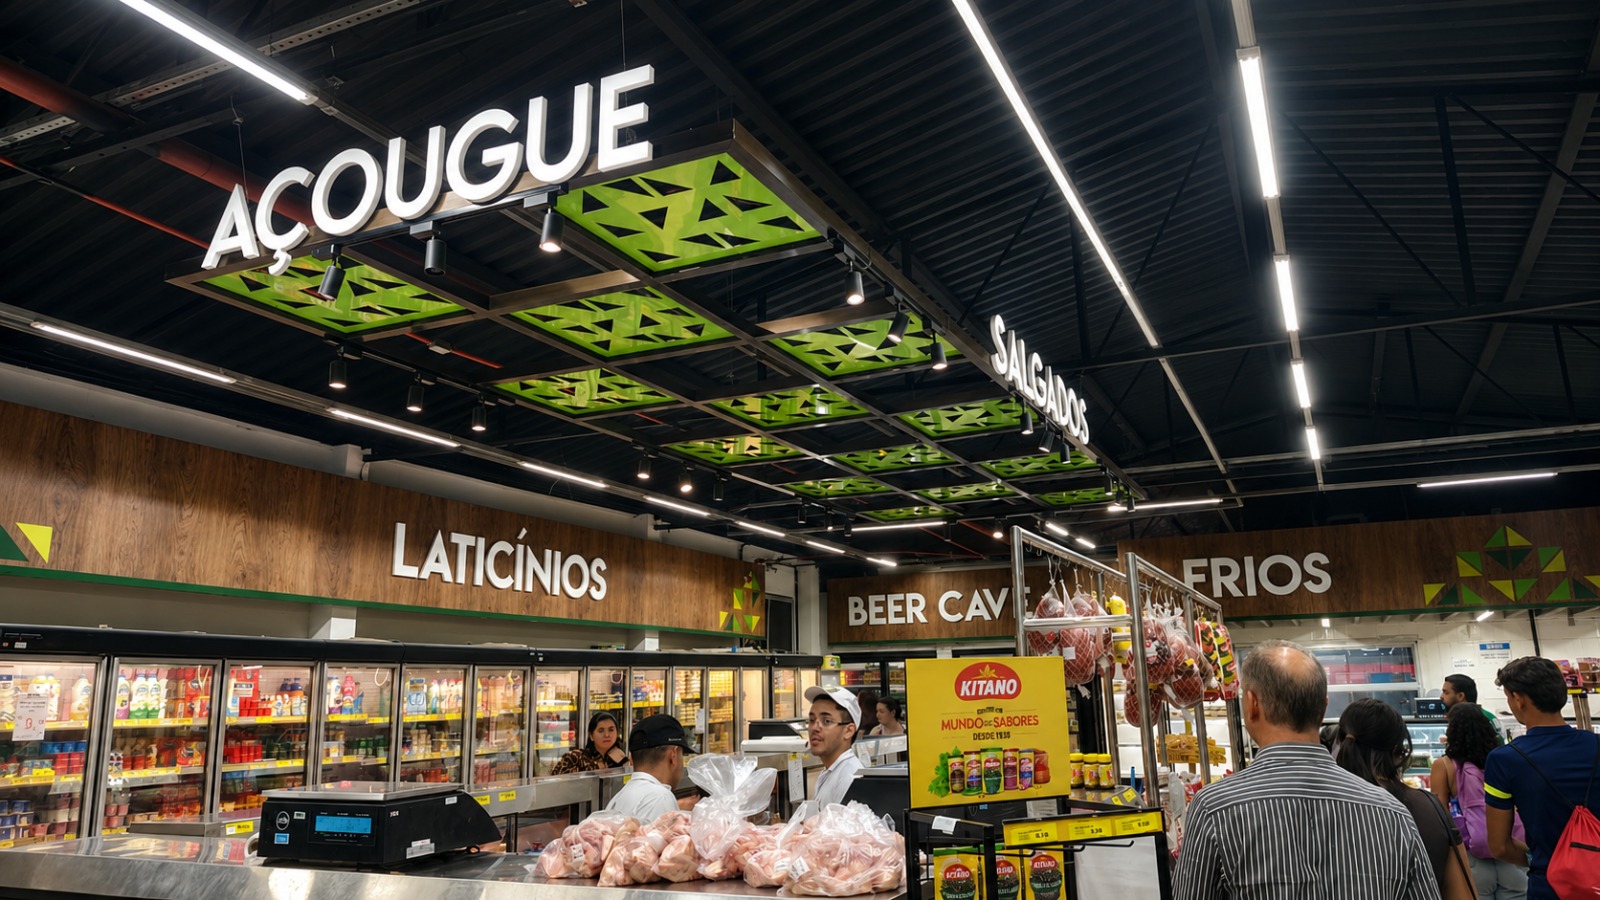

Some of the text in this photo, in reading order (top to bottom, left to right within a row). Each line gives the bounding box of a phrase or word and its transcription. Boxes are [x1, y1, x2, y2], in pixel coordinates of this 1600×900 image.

[201, 64, 654, 275] AÇOUGUE
[990, 314, 1089, 445] SALGADOS
[392, 522, 607, 600] LATICÍNIOS
[1182, 552, 1332, 598] FRIOS
[848, 593, 928, 626] BEER
[960, 678, 1017, 696] KITANO
[941, 717, 984, 731] MUNDO
[993, 715, 1039, 728] SABORES
[973, 732, 995, 741] DESDE
